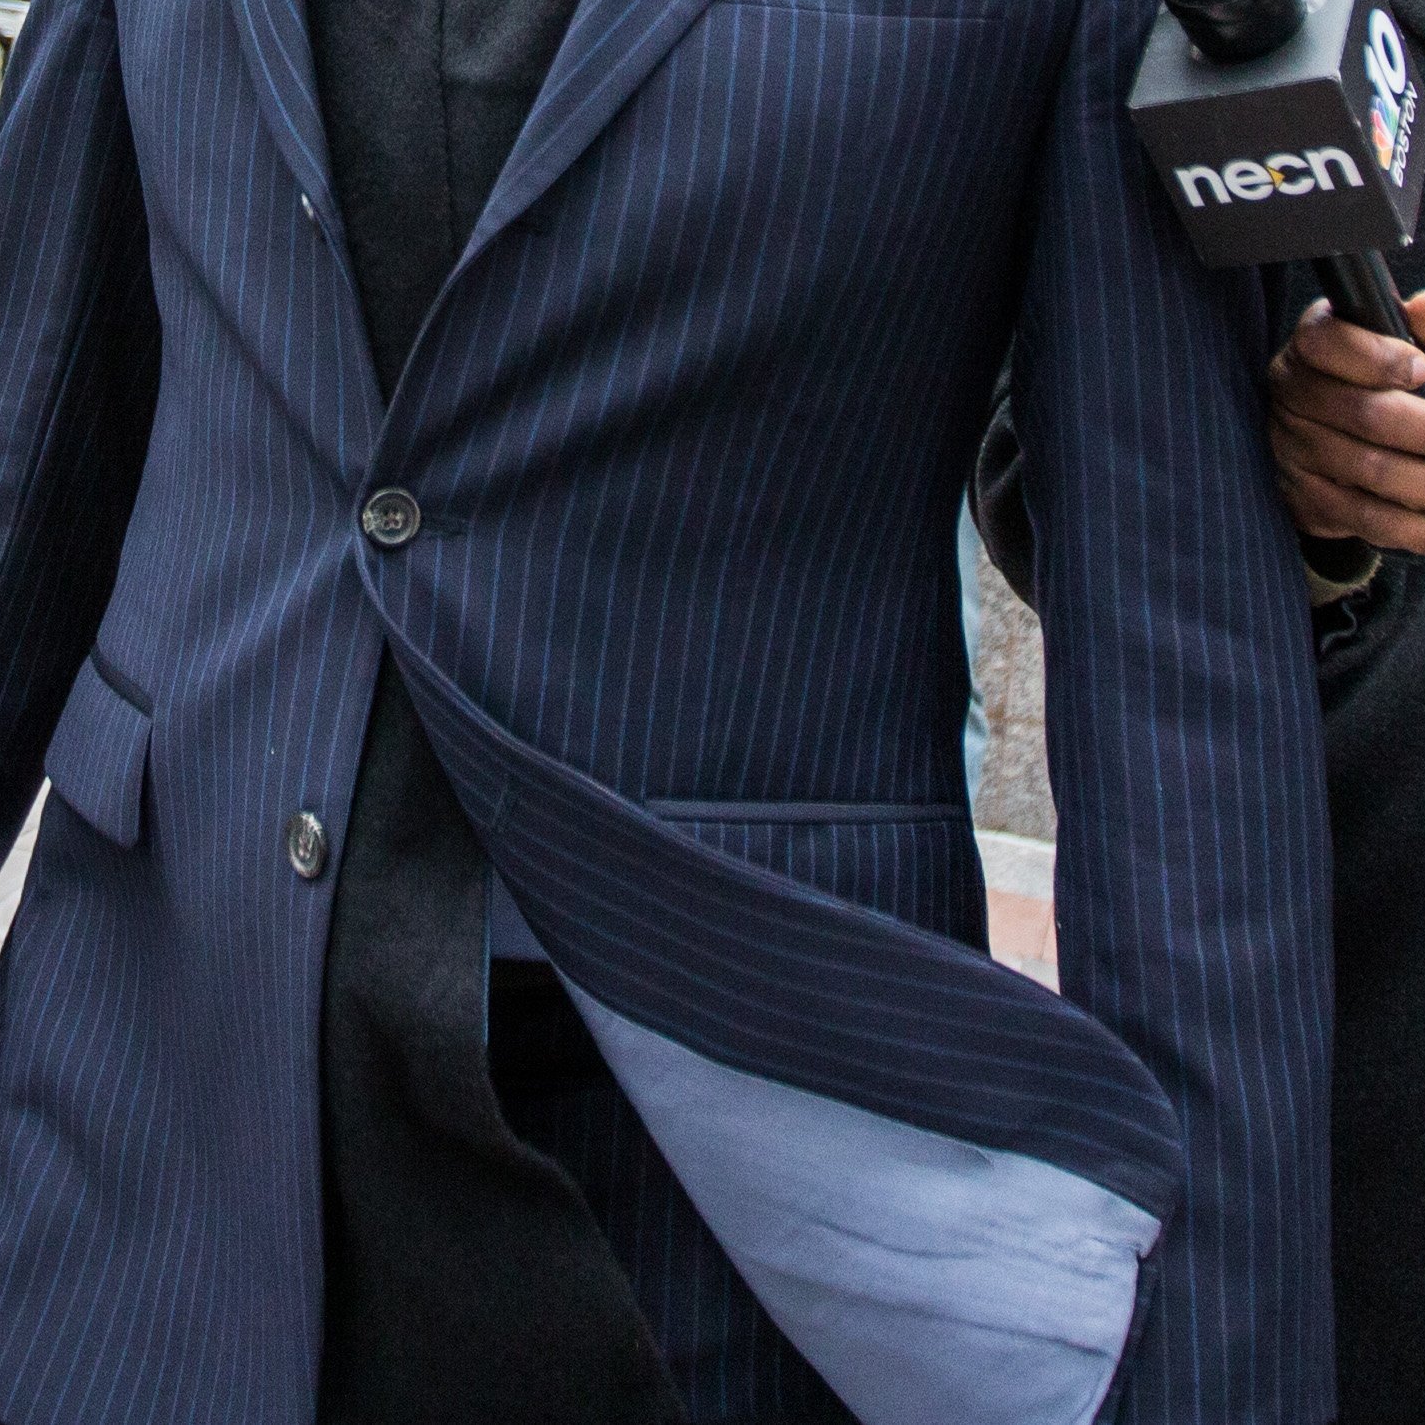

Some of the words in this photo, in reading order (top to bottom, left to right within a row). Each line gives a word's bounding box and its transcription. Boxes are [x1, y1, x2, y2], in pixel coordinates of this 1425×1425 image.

[1362, 7, 1407, 108] 10
[1173, 145, 1365, 208] necn
[1390, 80, 1418, 188] BOSTON
